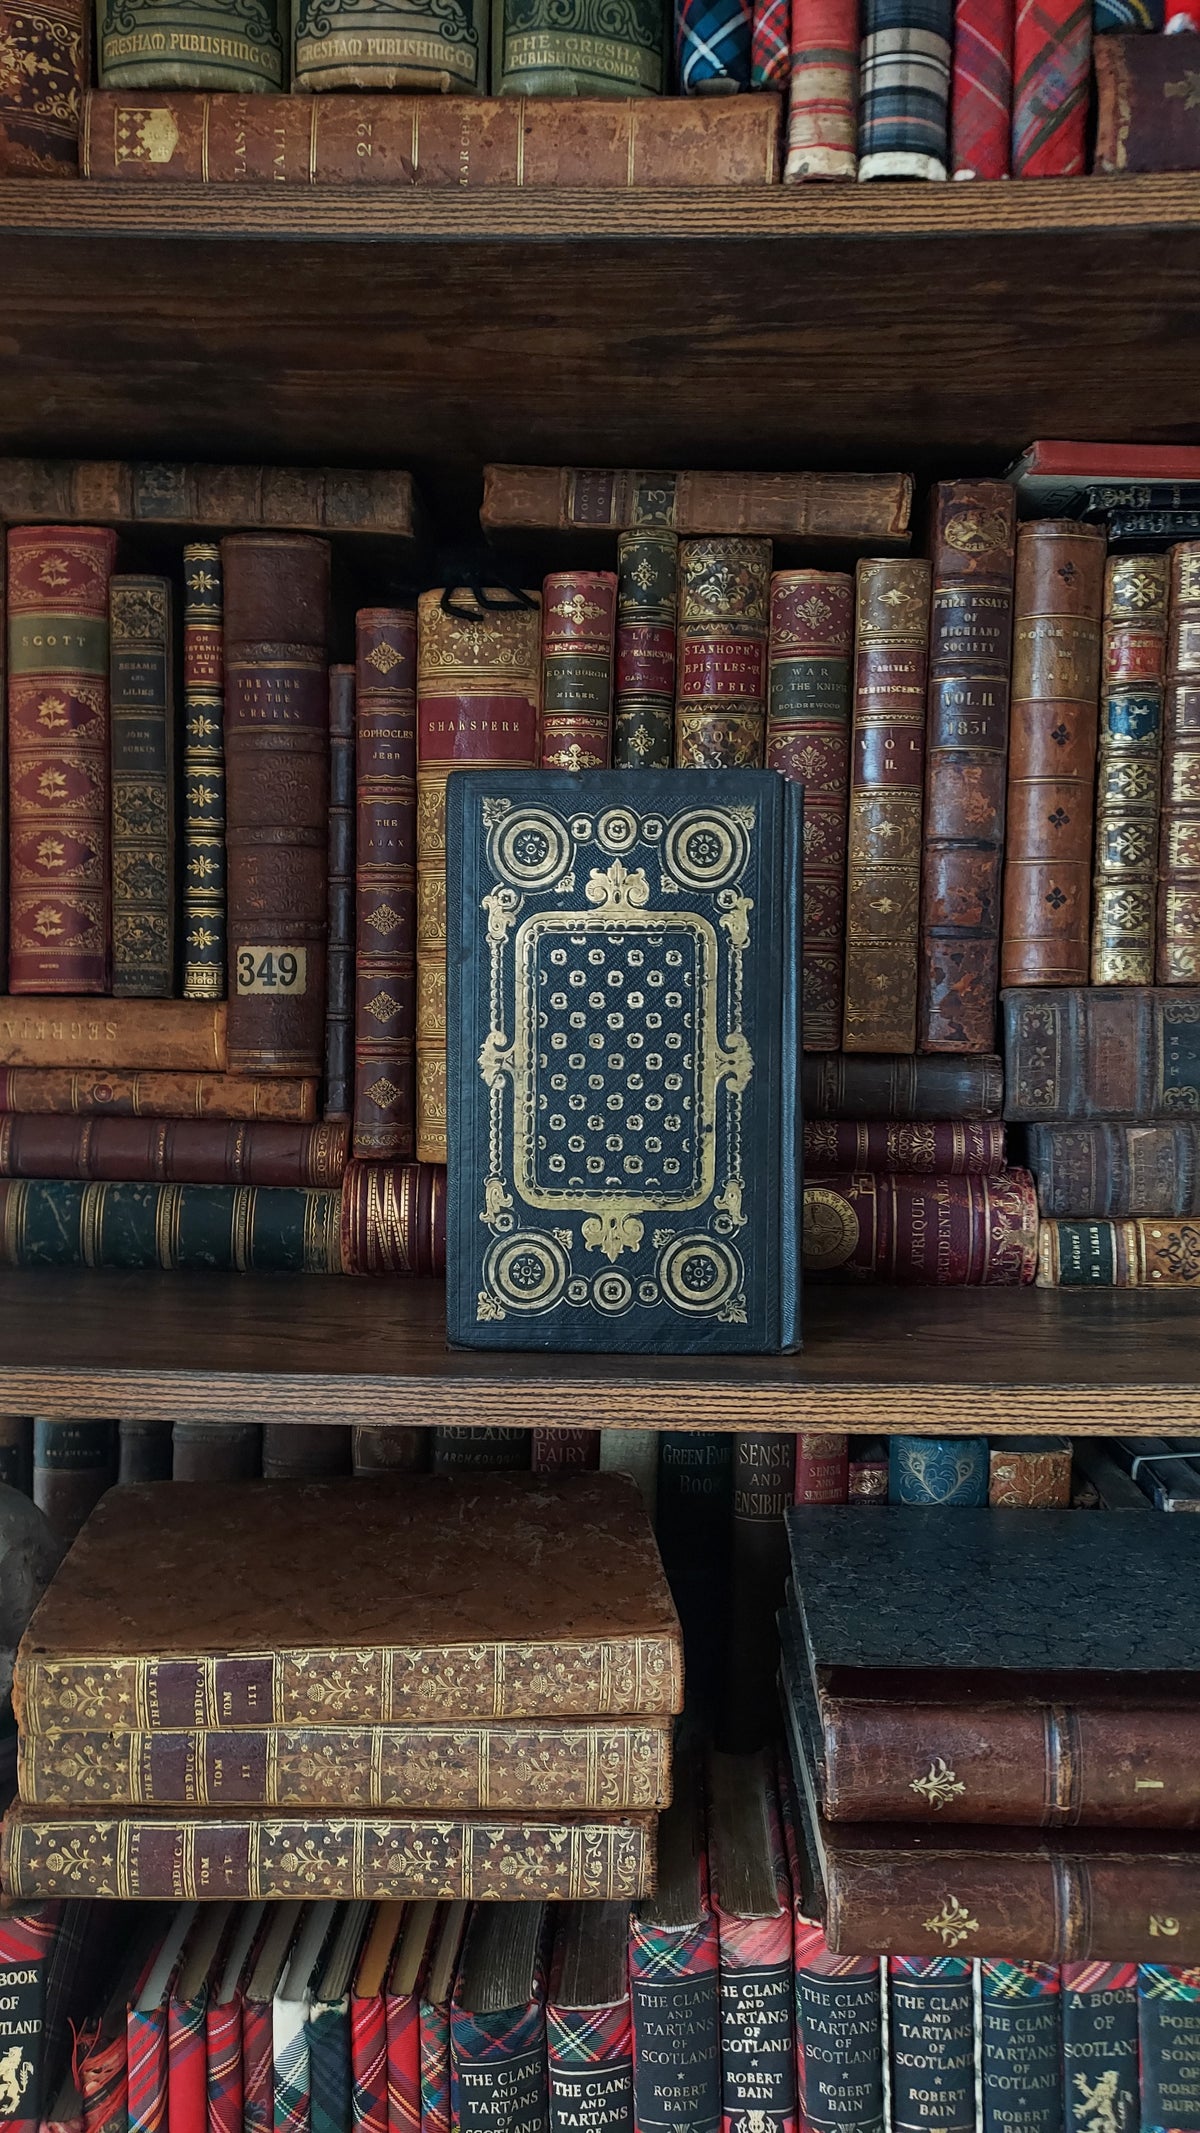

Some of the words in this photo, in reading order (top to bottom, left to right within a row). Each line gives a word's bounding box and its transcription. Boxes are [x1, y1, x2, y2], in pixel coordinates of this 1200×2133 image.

[170, 33, 259, 64] PUBLISHING
[367, 38, 455, 63] PUBLISHING
[510, 35, 550, 53] THE
[565, 39, 642, 64] GRESHA
[356, 123, 372, 157] 22
[964, 613, 979, 622] OF
[22, 635, 86, 647] SCOTT
[943, 642, 995, 653] SOCIETY
[546, 669, 608, 679] EDINBURGH
[792, 668, 829, 676] WAR
[684, 681, 755, 693] GOSPELS
[790, 682, 810, 691] THE
[429, 720, 520, 732] SHAKSPERE
[359, 729, 413, 739] SOPHOCLES
[375, 819, 398, 827] THE
[239, 951, 298, 988] 349
[911, 1196, 927, 1268] AFRIQUE
[739, 1441, 790, 1468] SENSE
[809, 1465, 841, 1477] SENSE
[749, 1473, 782, 1487] AND
[248, 1684, 257, 1706] III
[223, 1691, 232, 1716] TOM
[213, 1759, 223, 1787] TOM
[241, 1764, 250, 1778] II
[1134, 1777, 1164, 1793] 1
[200, 1857, 210, 1885] TOM
[1149, 1915, 1180, 1937] 2
[721, 1984, 738, 1998] HE
[742, 1979, 790, 1998] CLANS
[0, 1996, 19, 2011] OF
[637, 1992, 669, 2009] THE
[672, 1988, 717, 2008] CLANS
[736, 1999, 764, 2009] AND
[801, 1986, 830, 2006] THE
[834, 1990, 880, 2007] CLANS
[894, 1993, 925, 2010] THE
[930, 1995, 970, 2011] CLAN
[1069, 1994, 1082, 2009] A
[667, 2009, 693, 2020] AND
[721, 2009, 789, 2025] ARTANS
[828, 2009, 856, 2019] AND
[923, 2013, 951, 2024] AND
[0, 2019, 42, 2036] TLAND
[643, 2017, 715, 2036] TARTANS
[806, 2016, 878, 2036] TARTANS
[1015, 2013, 1056, 2031] CLAN
[1093, 2015, 1115, 2030] OF
[744, 2026, 761, 2038] OF
[899, 2023, 972, 2041] TARTANS
[1008, 2034, 1035, 2045] AND
[672, 2038, 688, 2049] OF
[721, 2038, 791, 2054] COTLAND
[835, 2038, 852, 2049] OF
[929, 2043, 945, 2054] OF
[641, 2046, 717, 2065] SCOTLAND
[805, 2044, 880, 2065] SCOTLAND
[985, 2044, 1057, 2062] TARTANS
[462, 2073, 493, 2087] THE
[497, 2061, 542, 2085] CLANS
[1013, 2064, 1030, 2074] OF
[726, 2071, 782, 2085] ROBERT
[491, 2086, 518, 2099] AND
[552, 2081, 581, 2098] THE
[585, 2076, 632, 2096] CLANS
[653, 2082, 708, 2098] ROBERT
[737, 2086, 773, 2099] BAIN
[818, 2081, 873, 2097] ROBERT
[1159, 2084, 1200, 2095] ROBE
[468, 2090, 539, 2115] TARTANS
[909, 2088, 966, 2102] ROBERT
[580, 2098, 607, 2110] AND
[664, 2100, 699, 2112] BAIN
[828, 2099, 863, 2112] BAIN
[919, 2104, 956, 2116] BAIN
[1162, 2100, 1200, 2112] BURN
[496, 2115, 513, 2127] OF
[557, 2106, 629, 2127] TARTANS
[993, 2109, 1050, 2123] ROBERT
